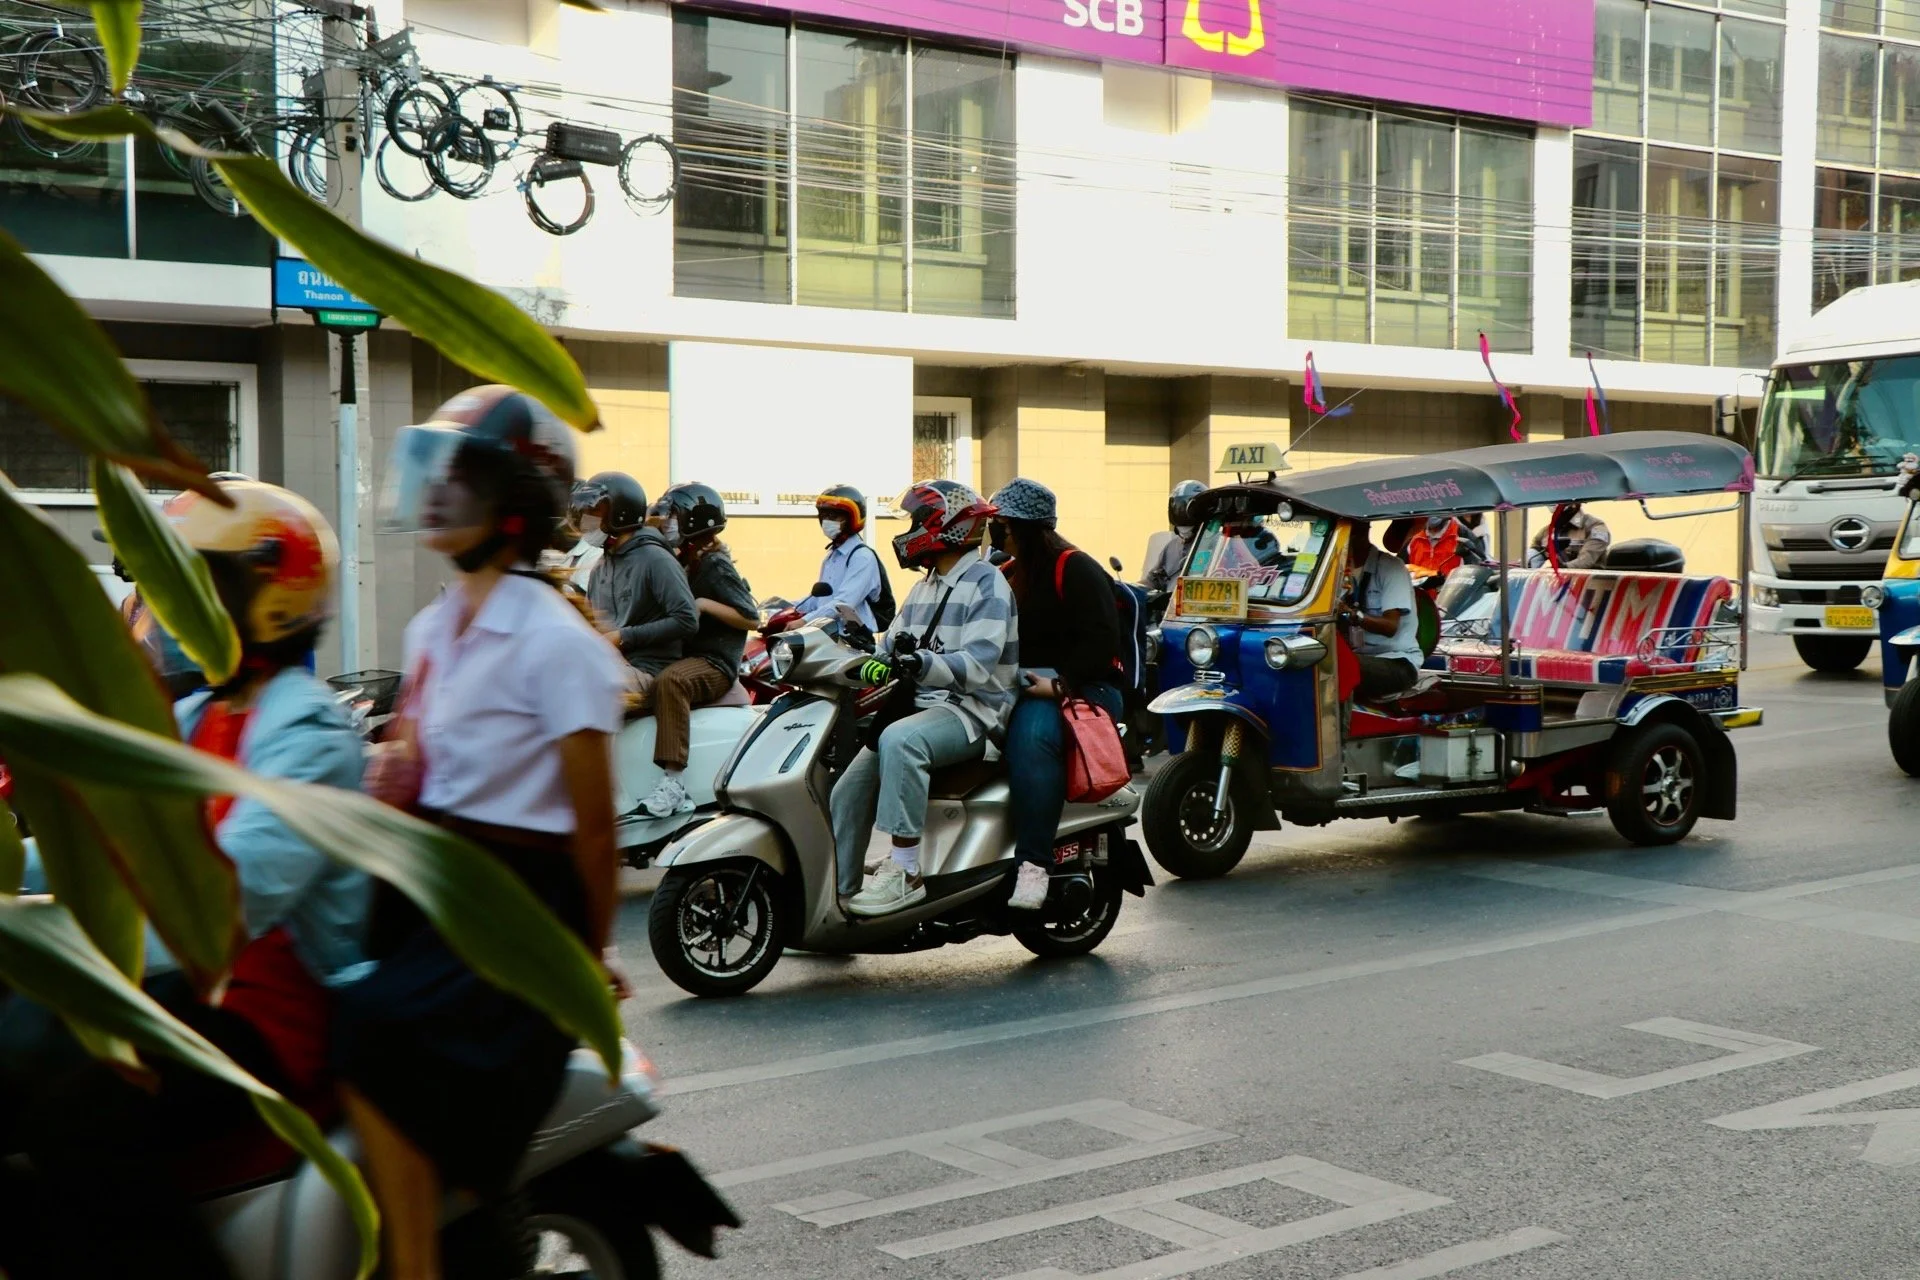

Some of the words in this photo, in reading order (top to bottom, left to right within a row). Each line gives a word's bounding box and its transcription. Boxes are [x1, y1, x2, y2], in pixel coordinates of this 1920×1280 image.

[1063, 0, 1144, 36] SCB
[297, 270, 345, 289] ถนน
[303, 289, 344, 301] Thanon
[1229, 446, 1265, 465] TAXI
[1522, 577, 1667, 643] MTM
